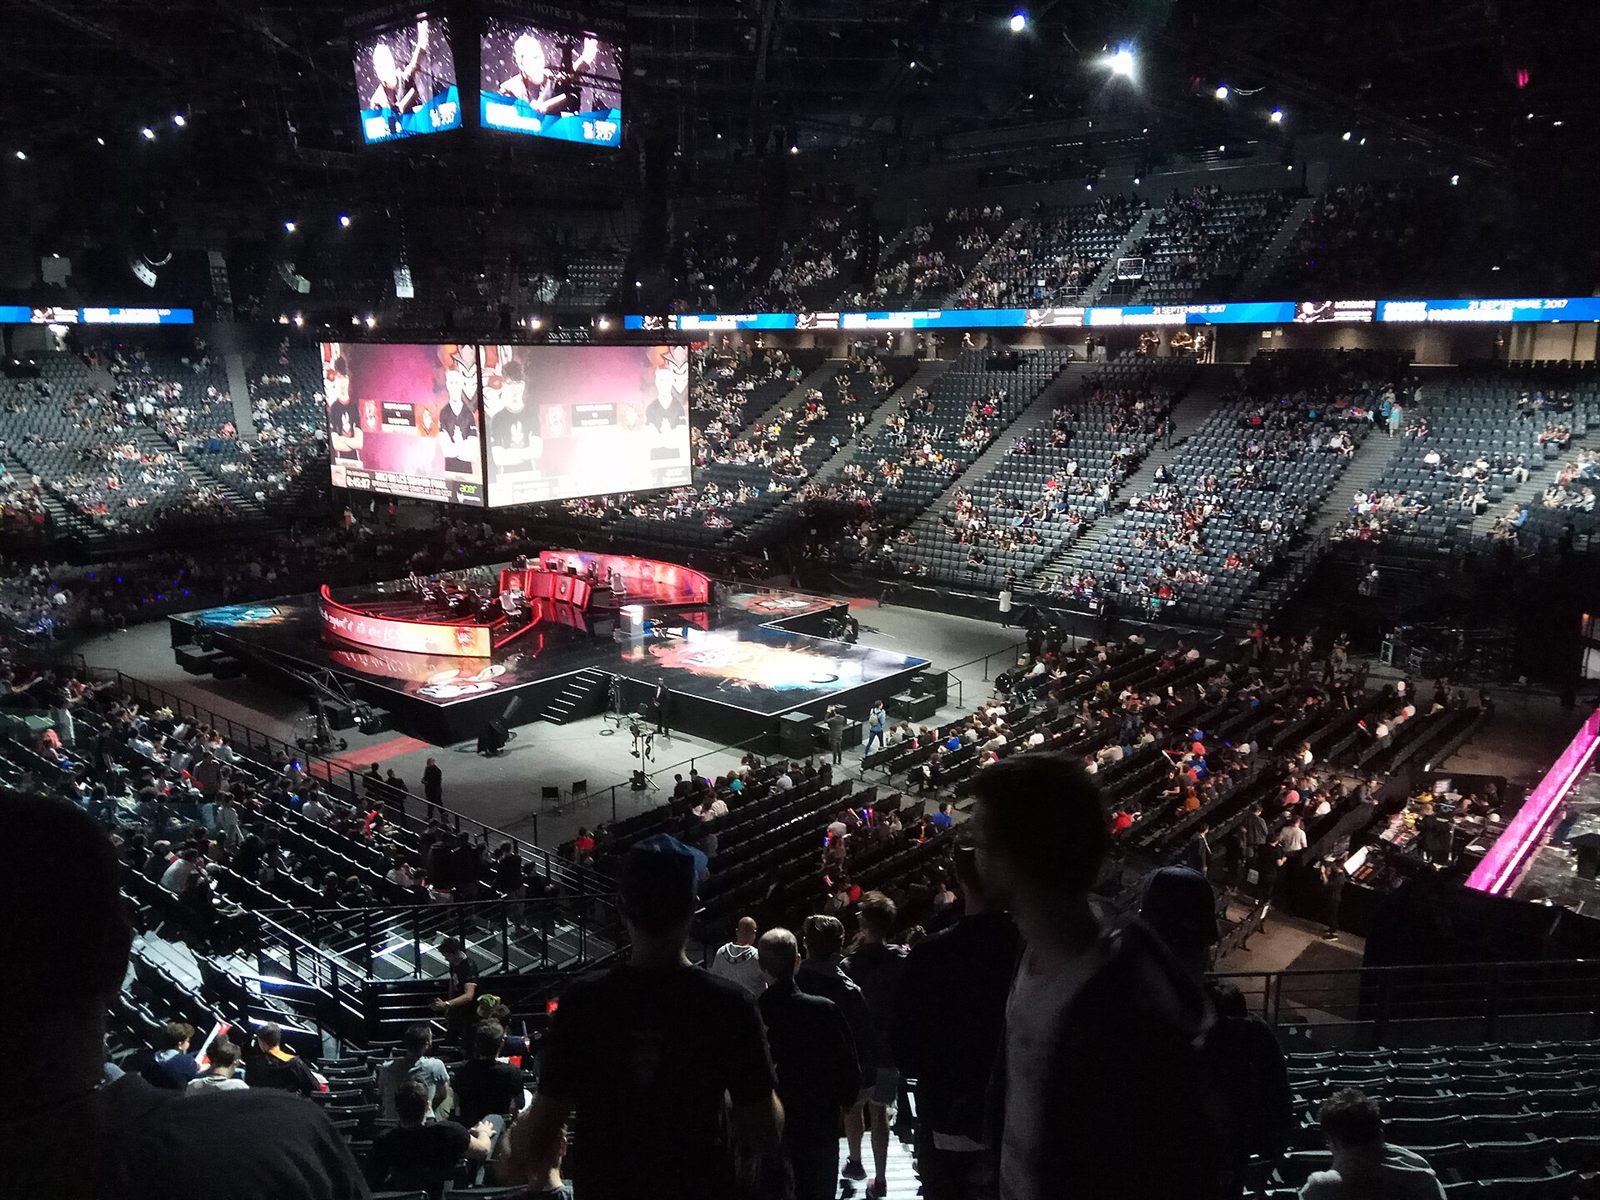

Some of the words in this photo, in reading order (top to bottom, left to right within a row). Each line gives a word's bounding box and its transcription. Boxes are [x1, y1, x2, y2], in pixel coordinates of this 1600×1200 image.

[1162, 306, 1207, 315] SEPTEMBRE
[1208, 304, 1226, 313] 2017
[1544, 300, 1568, 308] 2017
[459, 483, 478, 494] acer
